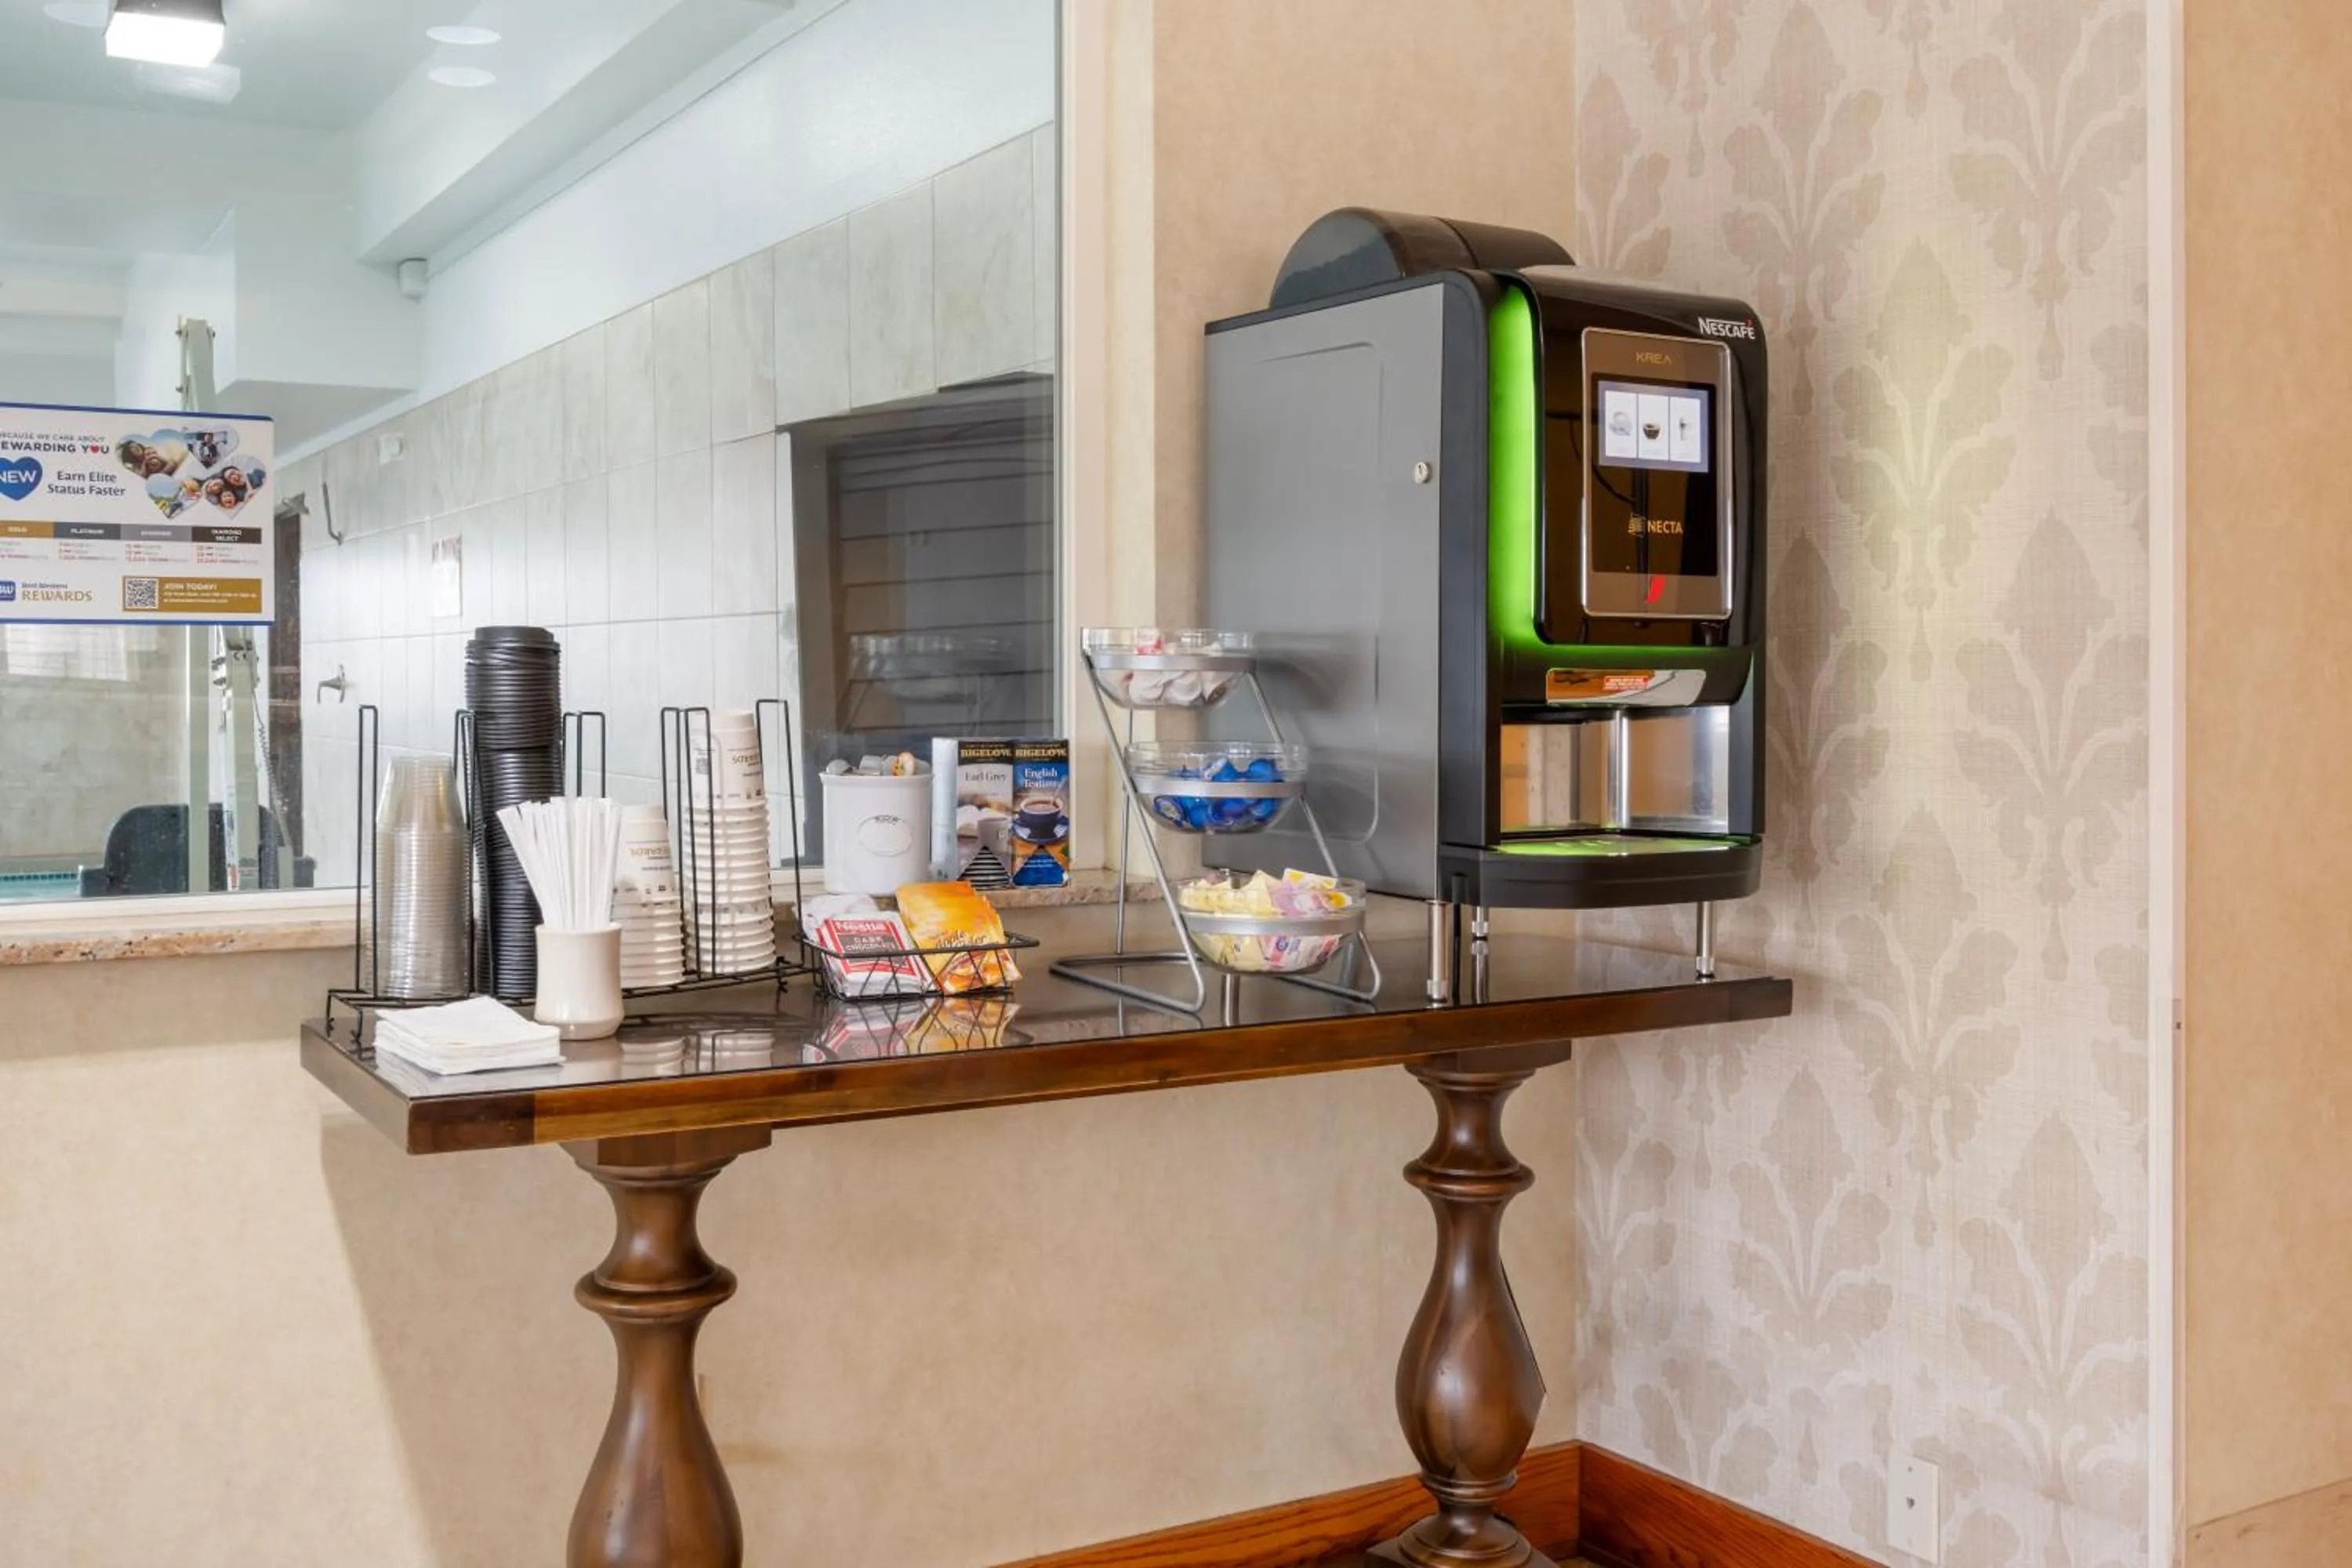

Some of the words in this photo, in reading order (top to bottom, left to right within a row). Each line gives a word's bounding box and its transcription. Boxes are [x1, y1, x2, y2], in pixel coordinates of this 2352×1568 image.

[57, 471, 85, 481] Earn
[89, 472, 117, 482] Elite
[48, 484, 85, 495] Status
[89, 485, 125, 496] Faster
[1647, 520, 1683, 534] NECTA
[22, 590, 93, 601] REWARDS
[1024, 767, 1058, 779] English
